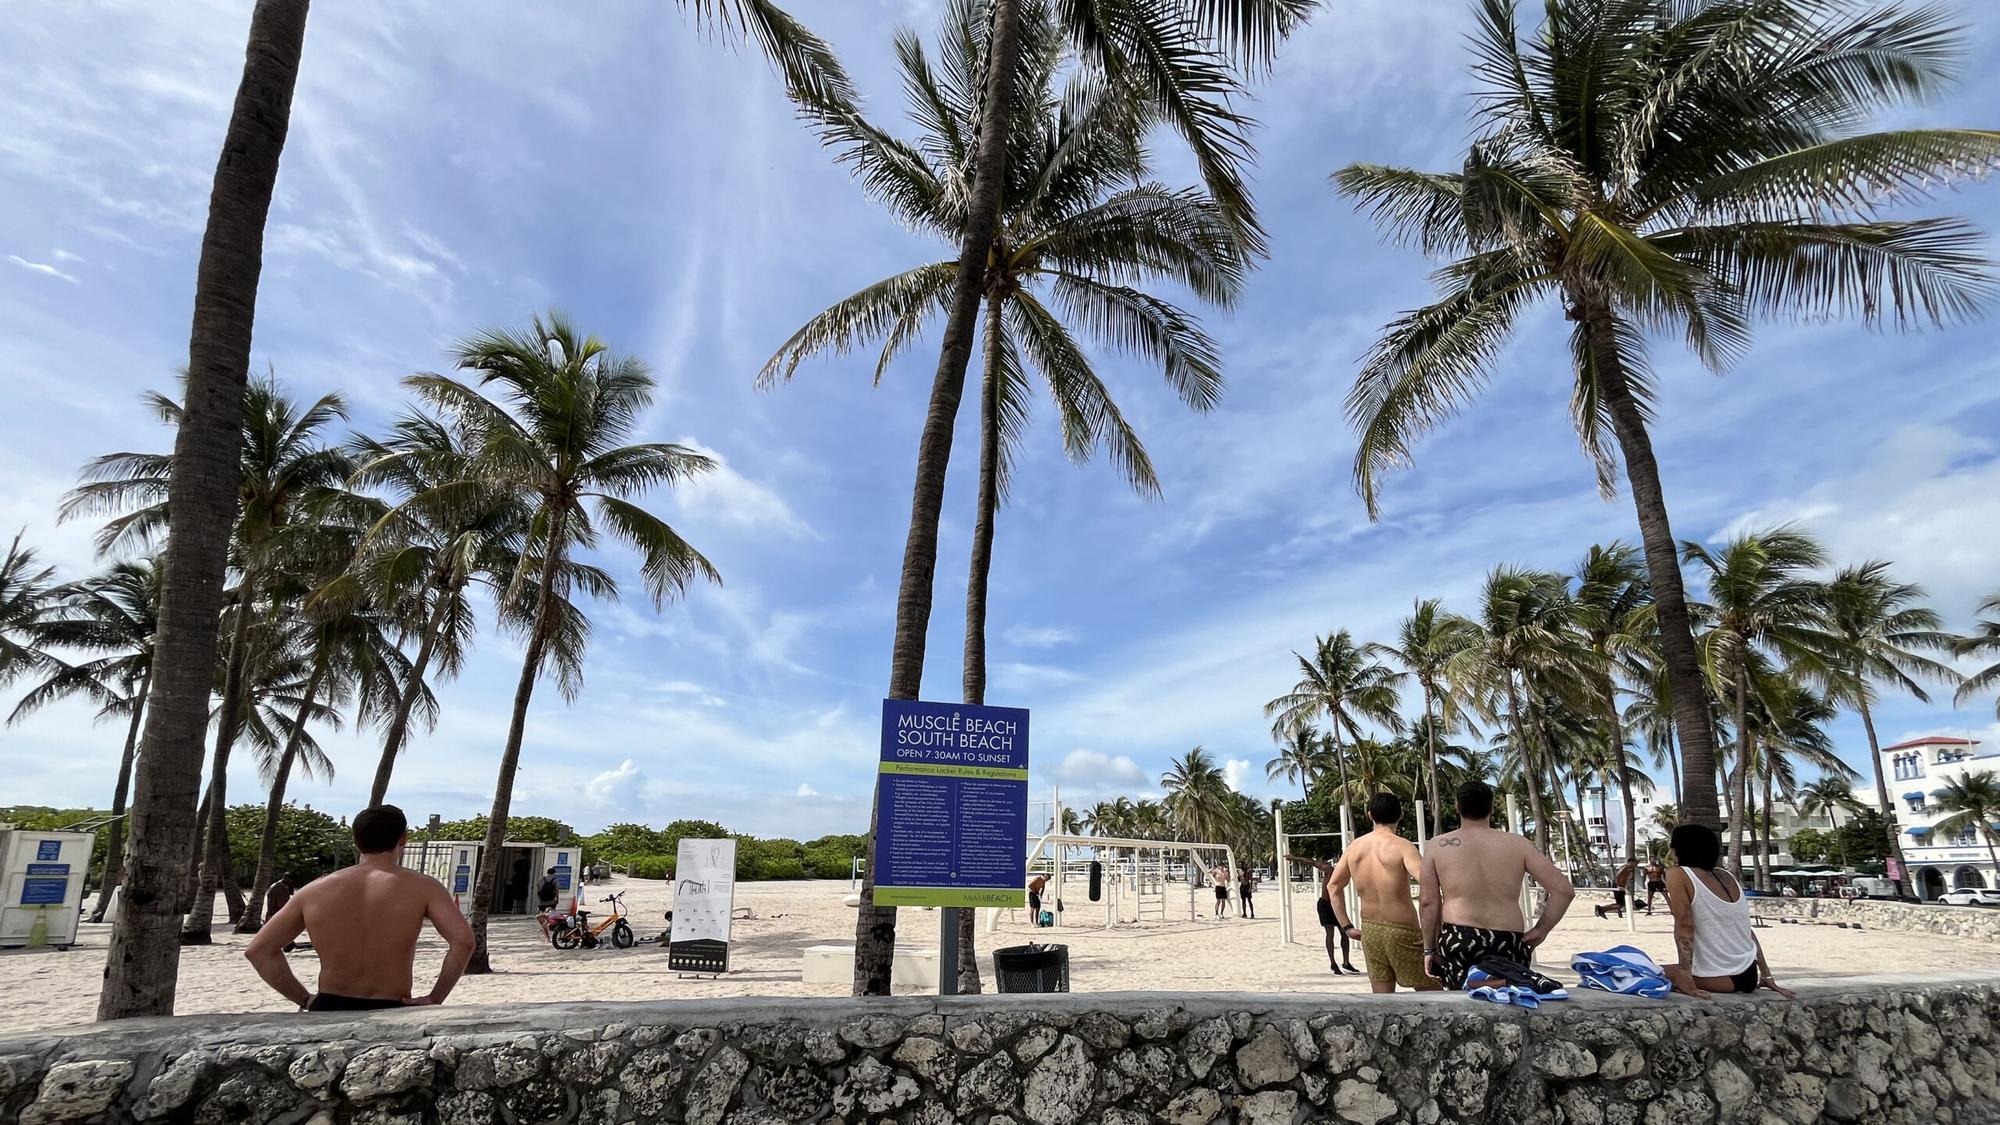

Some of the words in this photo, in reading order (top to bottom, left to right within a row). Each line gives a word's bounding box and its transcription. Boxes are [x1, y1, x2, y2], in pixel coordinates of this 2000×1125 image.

[898, 714, 960, 731] MUSCLE
[966, 718, 1016, 735] BEACH
[898, 730, 953, 747] SOUTH
[960, 734, 1012, 750] BEACH
[896, 749, 922, 758] OPEN
[925, 750, 960, 760] 7:30AM
[963, 752, 976, 761] TO
[977, 753, 1011, 763] SUNSET
[896, 765, 935, 773] Performance
[936, 767, 956, 775] Locker
[958, 768, 974, 776] Rules
